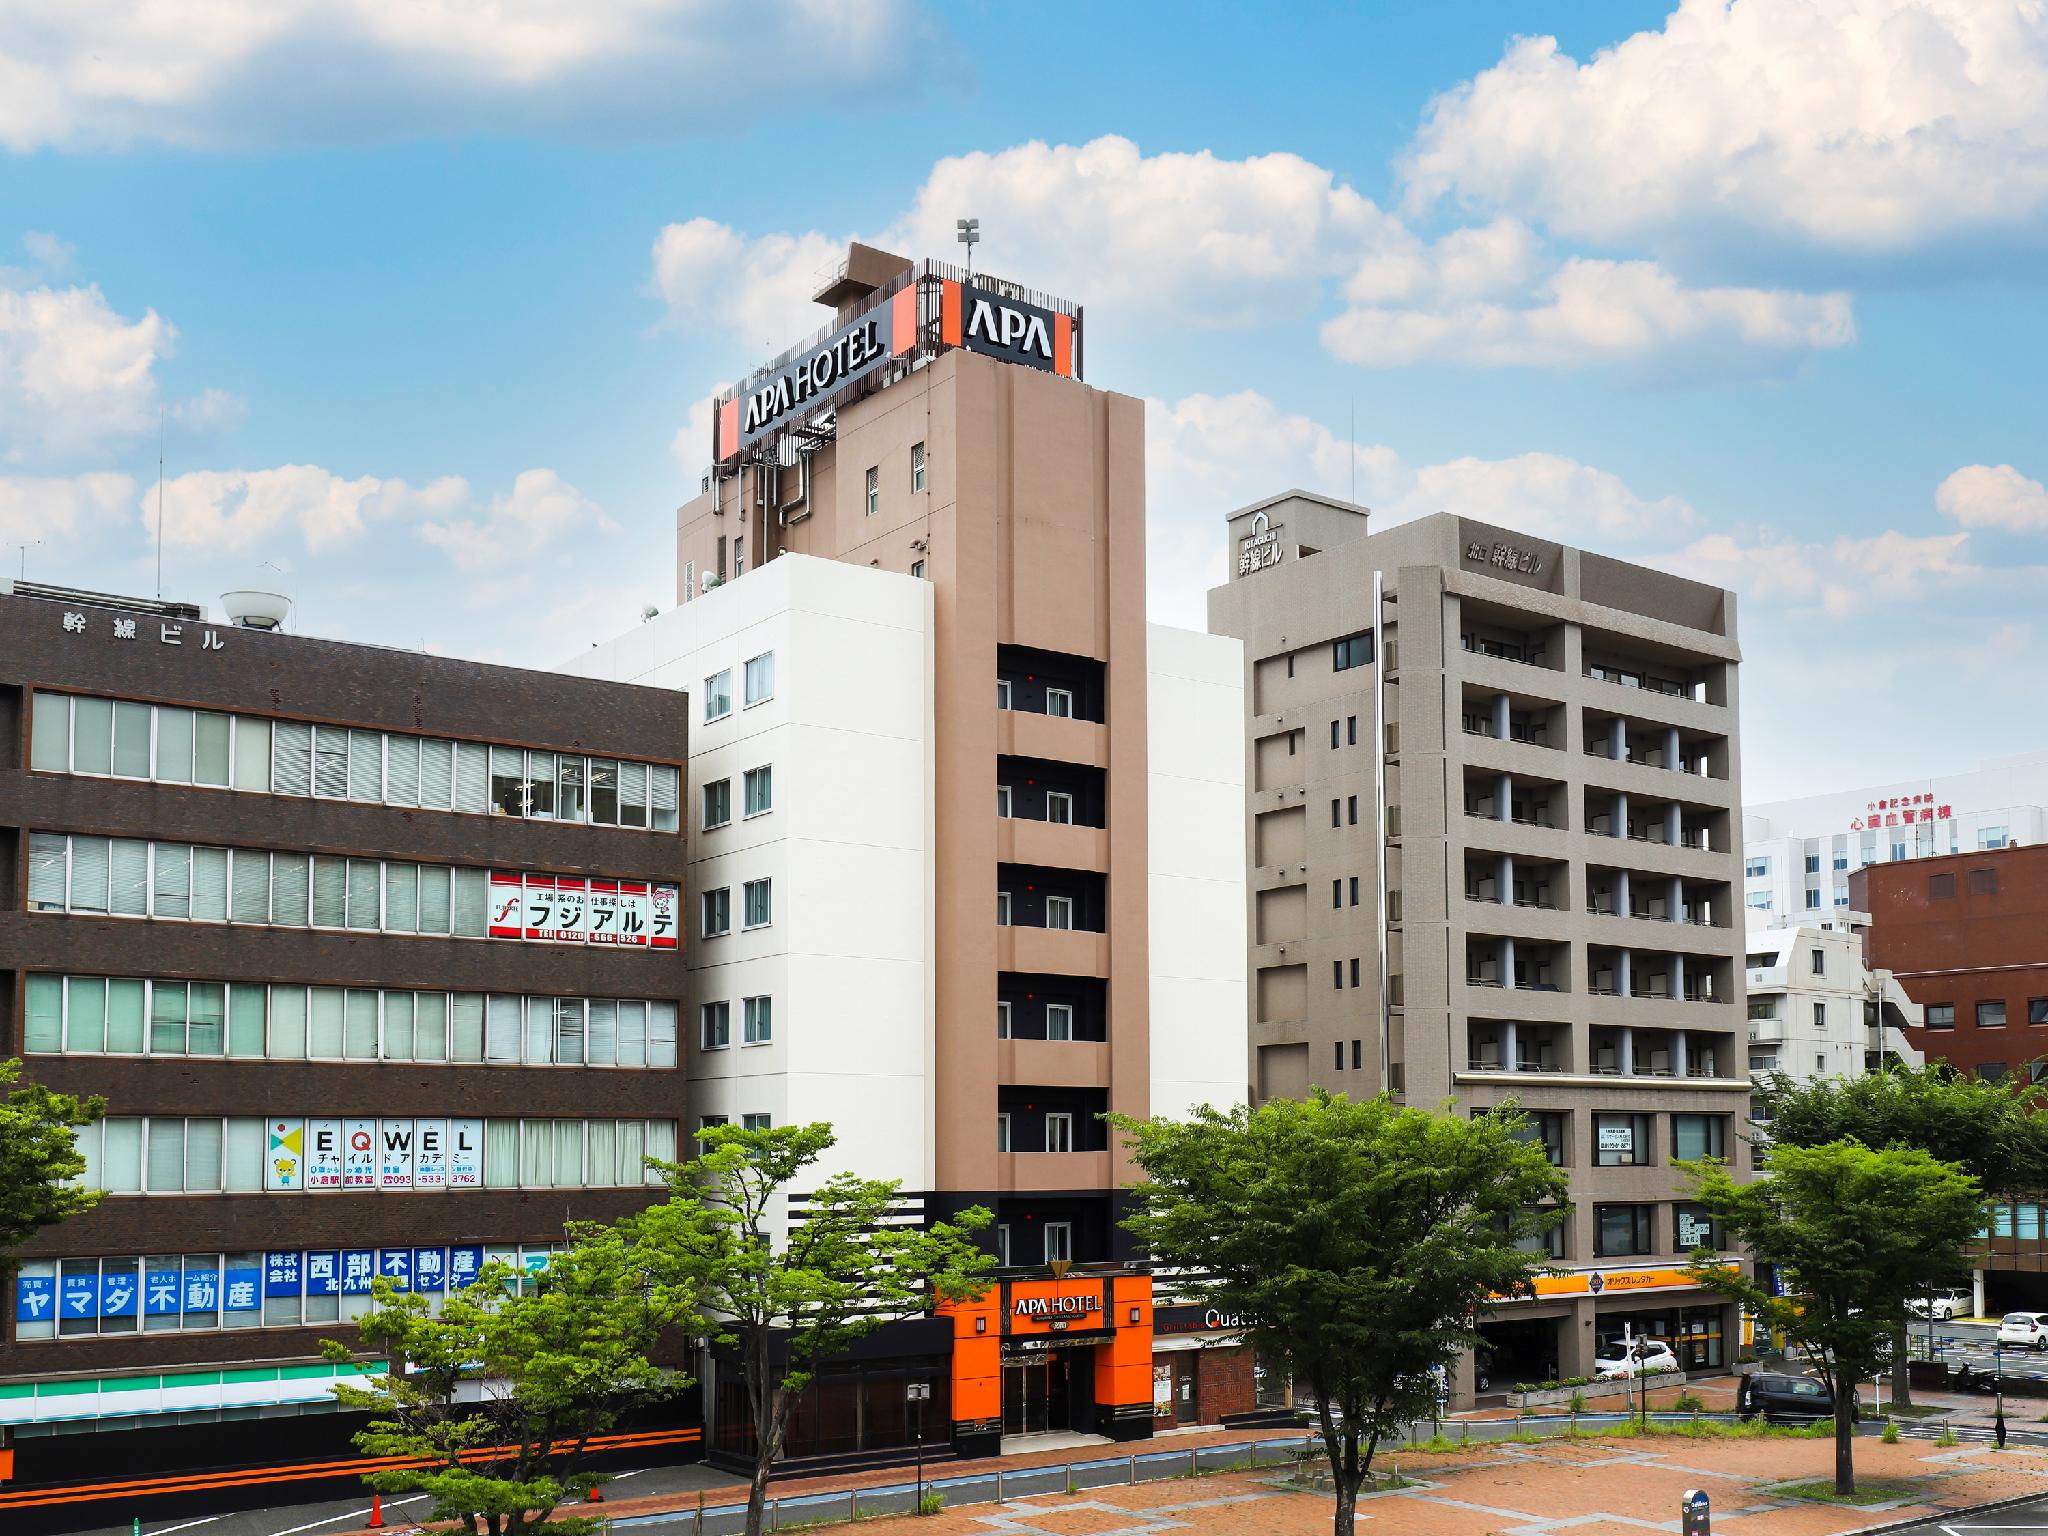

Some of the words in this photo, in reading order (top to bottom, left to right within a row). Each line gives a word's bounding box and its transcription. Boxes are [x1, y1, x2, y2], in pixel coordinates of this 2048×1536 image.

[968, 299, 1052, 358] APA
[744, 375, 792, 433] APA
[794, 321, 881, 402] HOTEL
[1239, 542, 1283, 576] 幹線ビル
[63, 611, 225, 651] 幹線ビル
[529, 906, 673, 936] フジアルテ
[538, 929, 553, 938] TEL
[317, 1131, 473, 1151] EQWEL
[310, 1250, 475, 1279] 西部不動産
[22, 1282, 254, 1317] ヤマダ不動産
[1016, 1298, 1048, 1314] APA
[1051, 1295, 1102, 1312] HOTEL
